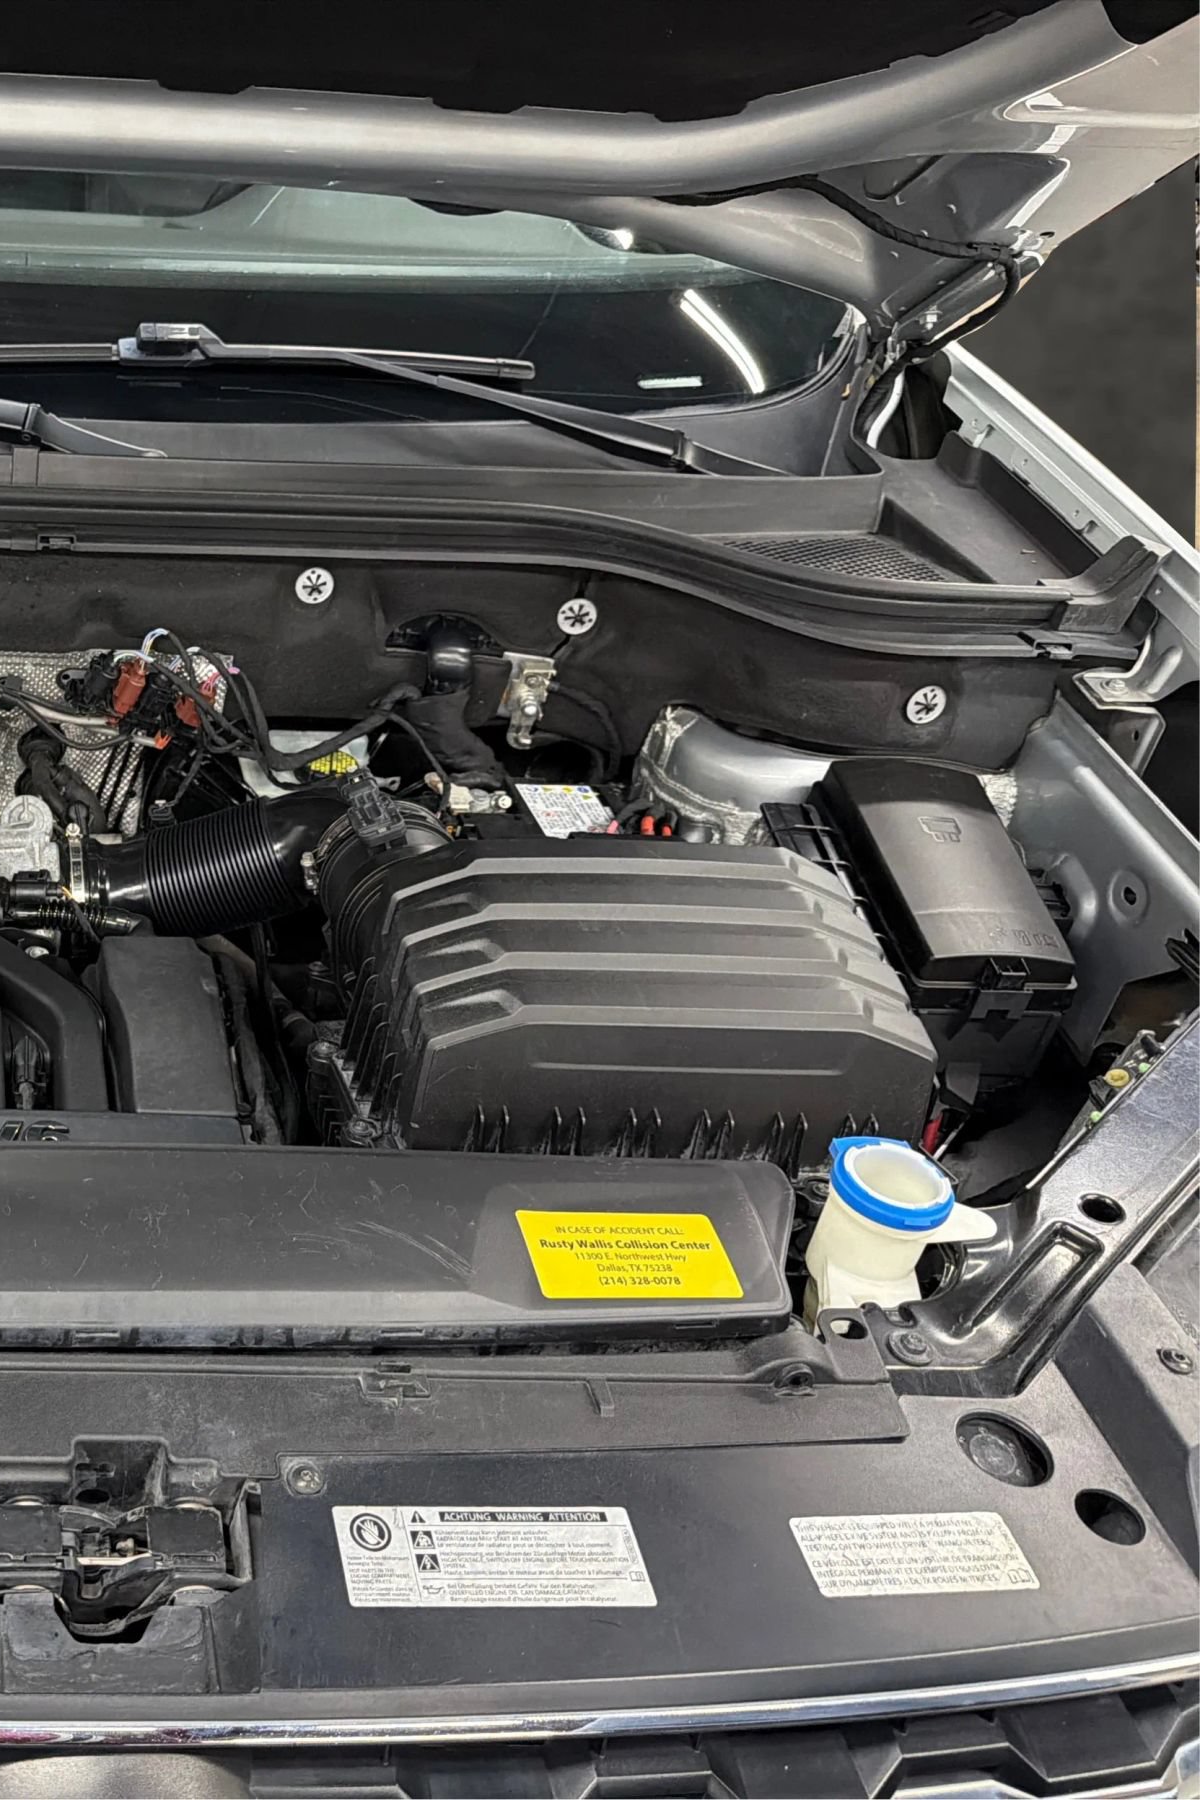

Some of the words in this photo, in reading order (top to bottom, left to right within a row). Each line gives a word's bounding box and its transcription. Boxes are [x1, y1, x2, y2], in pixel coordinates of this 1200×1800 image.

[556, 1226, 566, 1234] IN
[567, 1226, 592, 1234] CASE
[610, 1227, 656, 1235] ACCIDENT
[658, 1227, 684, 1235] CALL:
[540, 1240, 574, 1250] Rusty
[576, 1240, 613, 1249] Wallis
[616, 1240, 668, 1250] Collision
[671, 1241, 710, 1250] Center
[575, 1253, 604, 1261] 11300
[615, 1253, 664, 1261] Northwest
[667, 1253, 686, 1262] Hwy
[598, 1264, 628, 1273] Dallas,
[629, 1264, 643, 1272] TX
[644, 1264, 672, 1272] 75238
[600, 1276, 628, 1286] (214)
[630, 1277, 681, 1285] 328-0078
[443, 1513, 491, 1521] ACHTUNG
[495, 1513, 544, 1521] WARNING
[549, 1513, 600, 1521] ATTENTION
